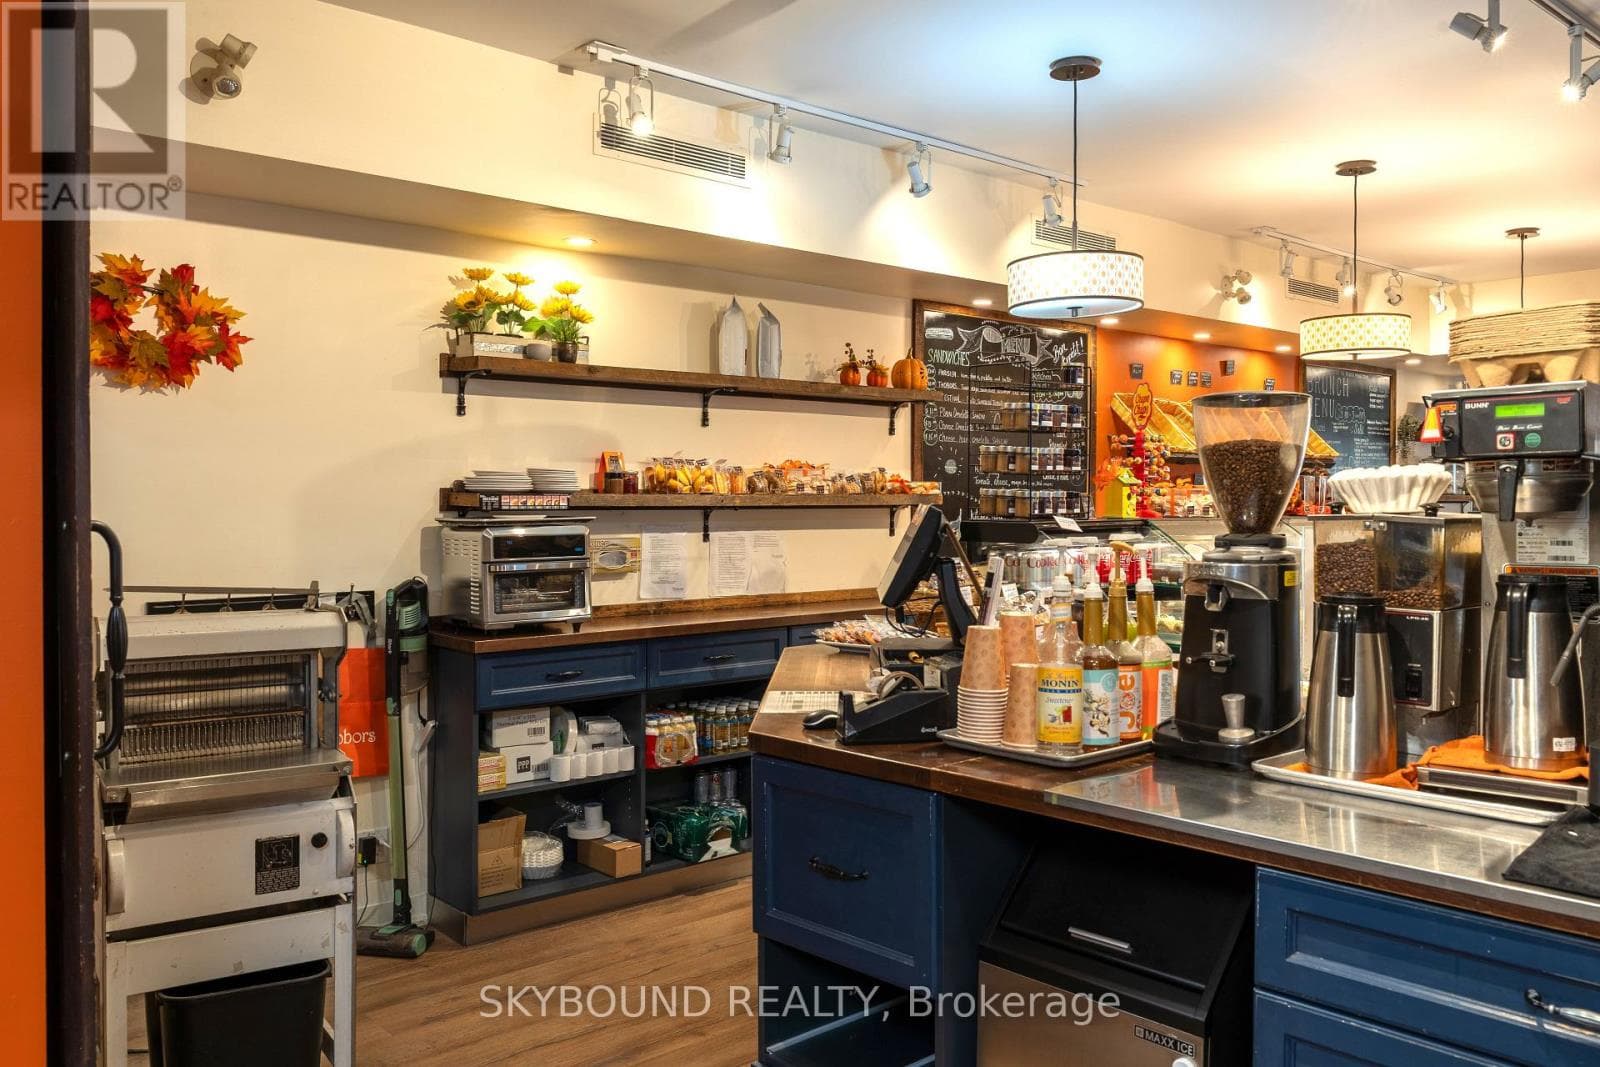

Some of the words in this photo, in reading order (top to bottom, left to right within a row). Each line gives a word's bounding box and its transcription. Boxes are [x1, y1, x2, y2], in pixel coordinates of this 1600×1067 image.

[1311, 397, 1335, 418] ENU
[1041, 679, 1079, 688] MONIN
[518, 760, 530, 770] PPP
[1145, 1030, 1175, 1049] MAXX
[1177, 1041, 1194, 1056] ICE
